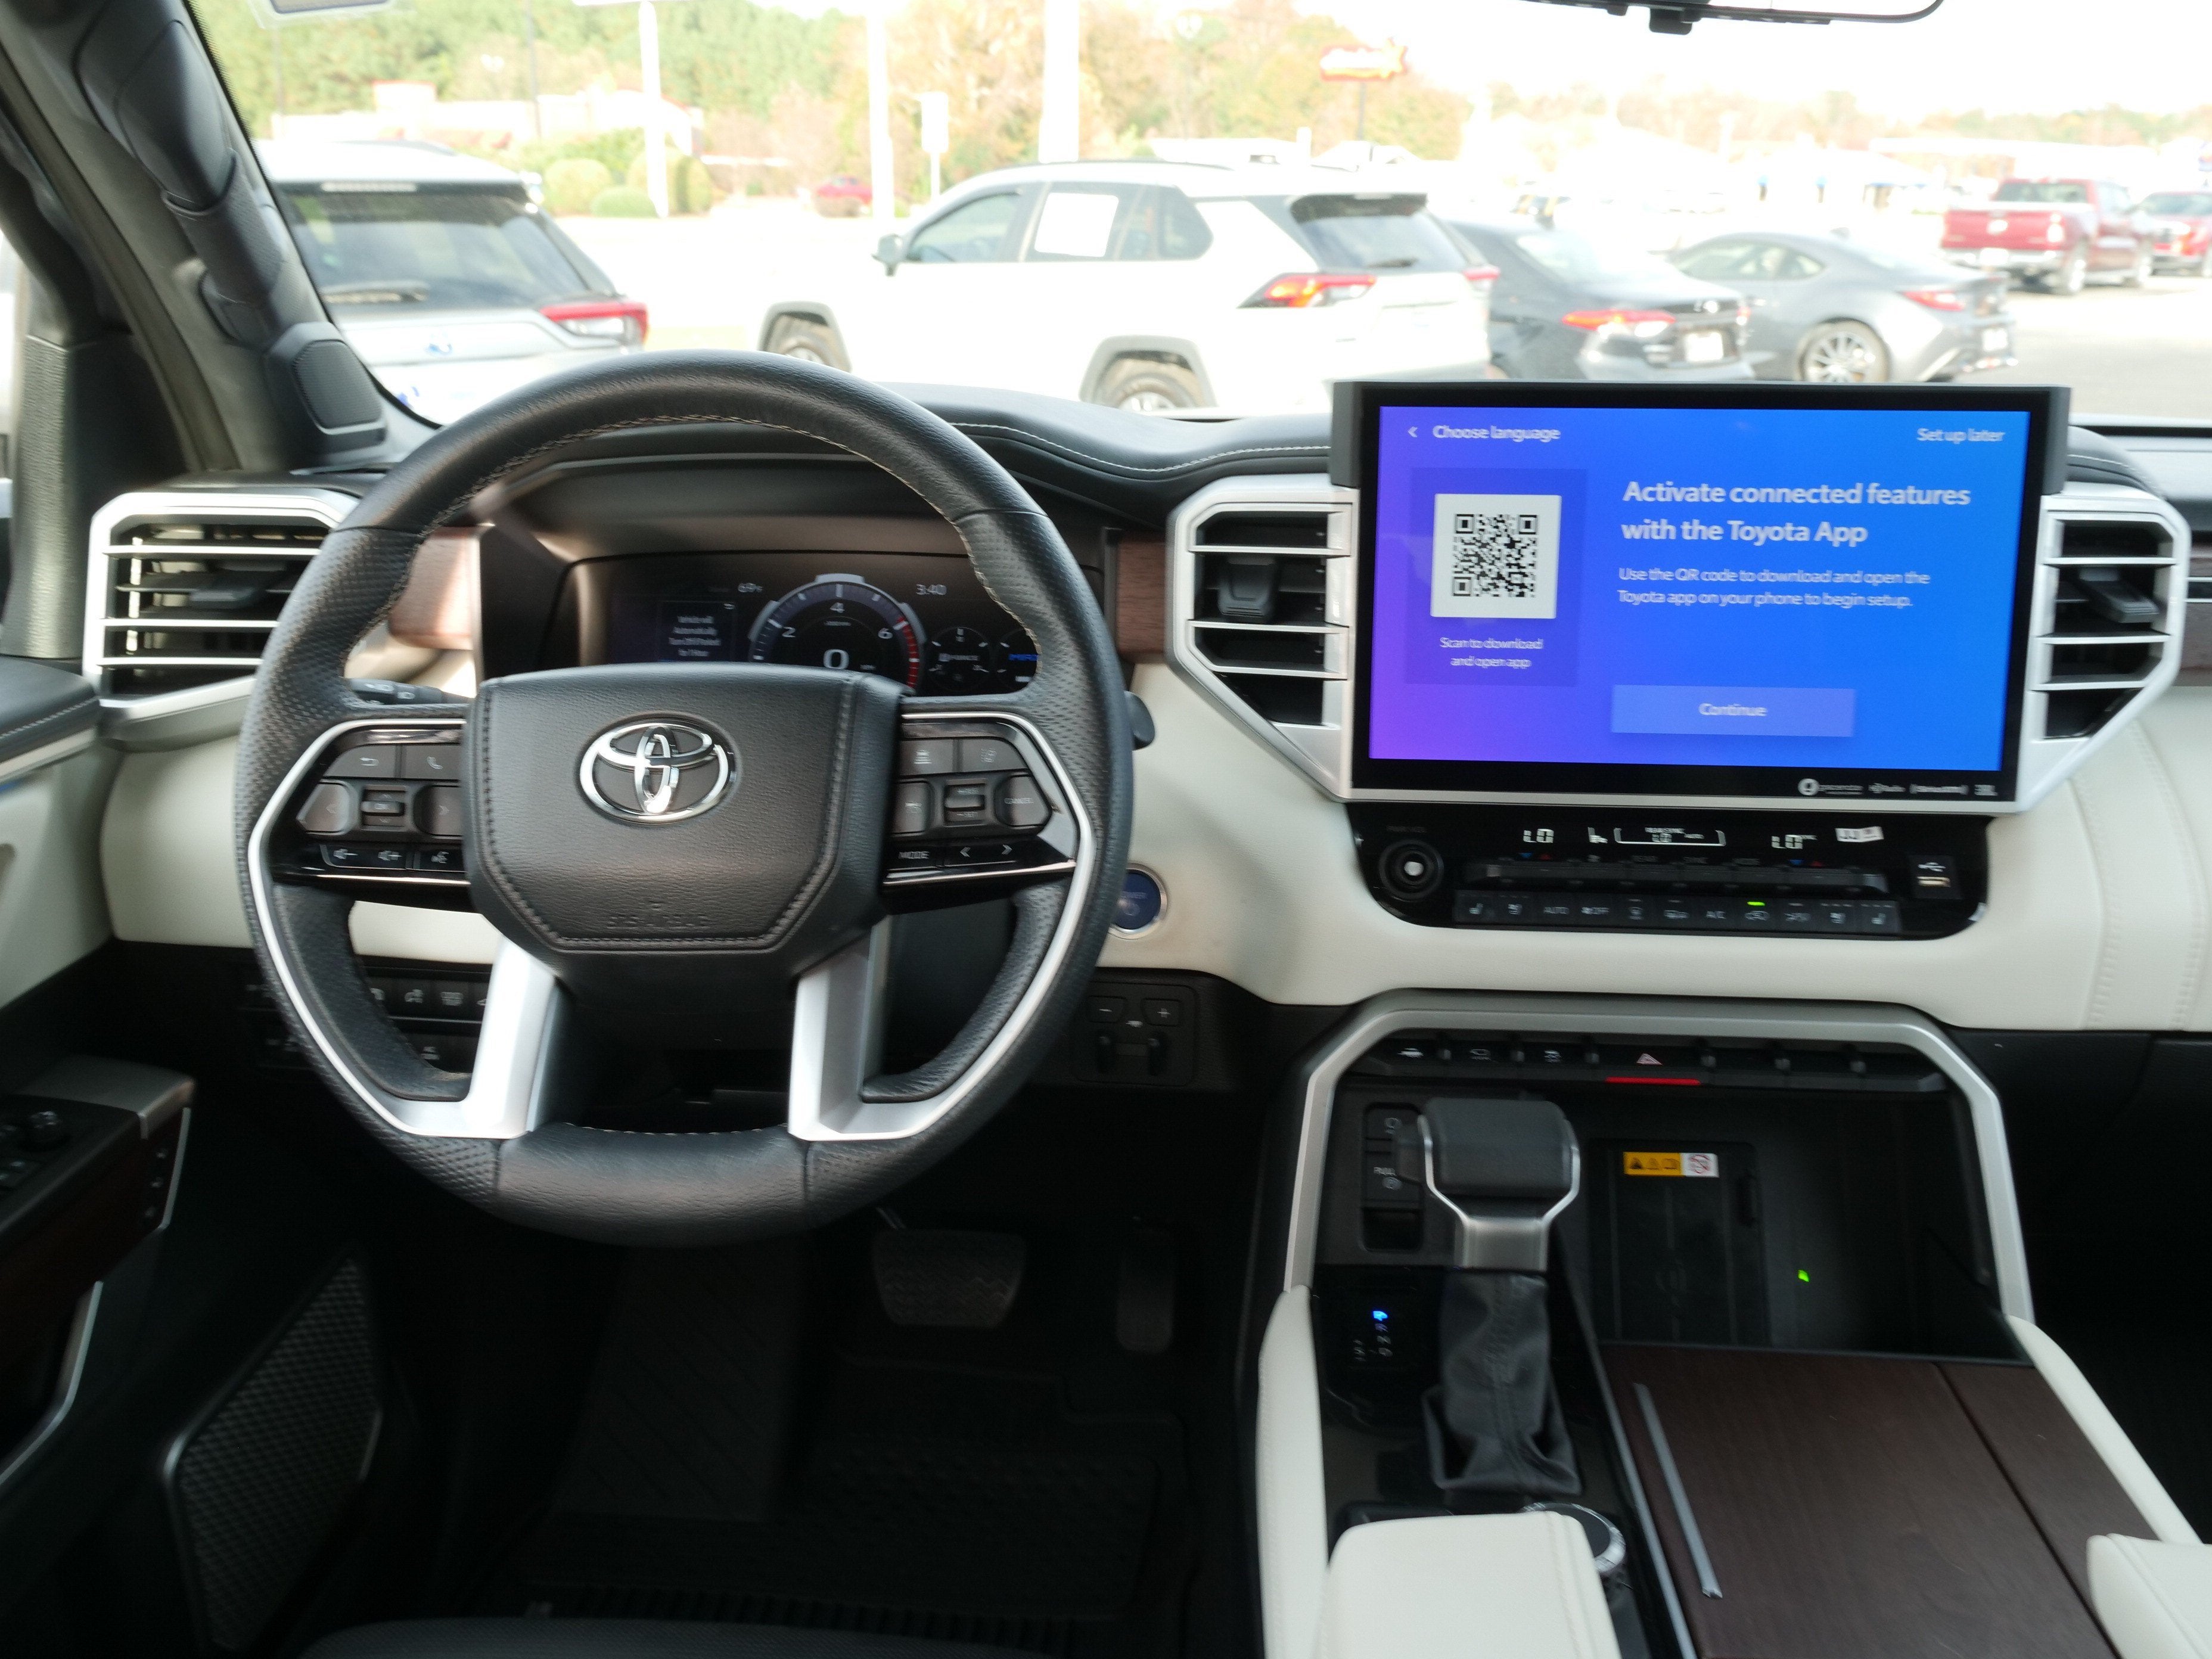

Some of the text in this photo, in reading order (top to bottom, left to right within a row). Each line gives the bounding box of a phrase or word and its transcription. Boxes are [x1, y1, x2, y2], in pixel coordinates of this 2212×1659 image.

[1433, 425, 1561, 442] Choose language
[1916, 428, 2006, 445] Set up later
[1622, 481, 1971, 505] Activate connected features
[1620, 518, 1869, 547] with the Toyota App
[1618, 567, 1930, 586] Use the QR code to download and open the
[830, 602, 846, 613] 4
[1617, 589, 1913, 609] Toyota app on your phone to begin setup.
[781, 626, 797, 638] 2
[877, 628, 893, 639] 6
[1440, 637, 1544, 650] Scan to download
[823, 648, 850, 670] 0
[1450, 655, 1531, 669] and open app
[1698, 703, 1767, 716] Continue
